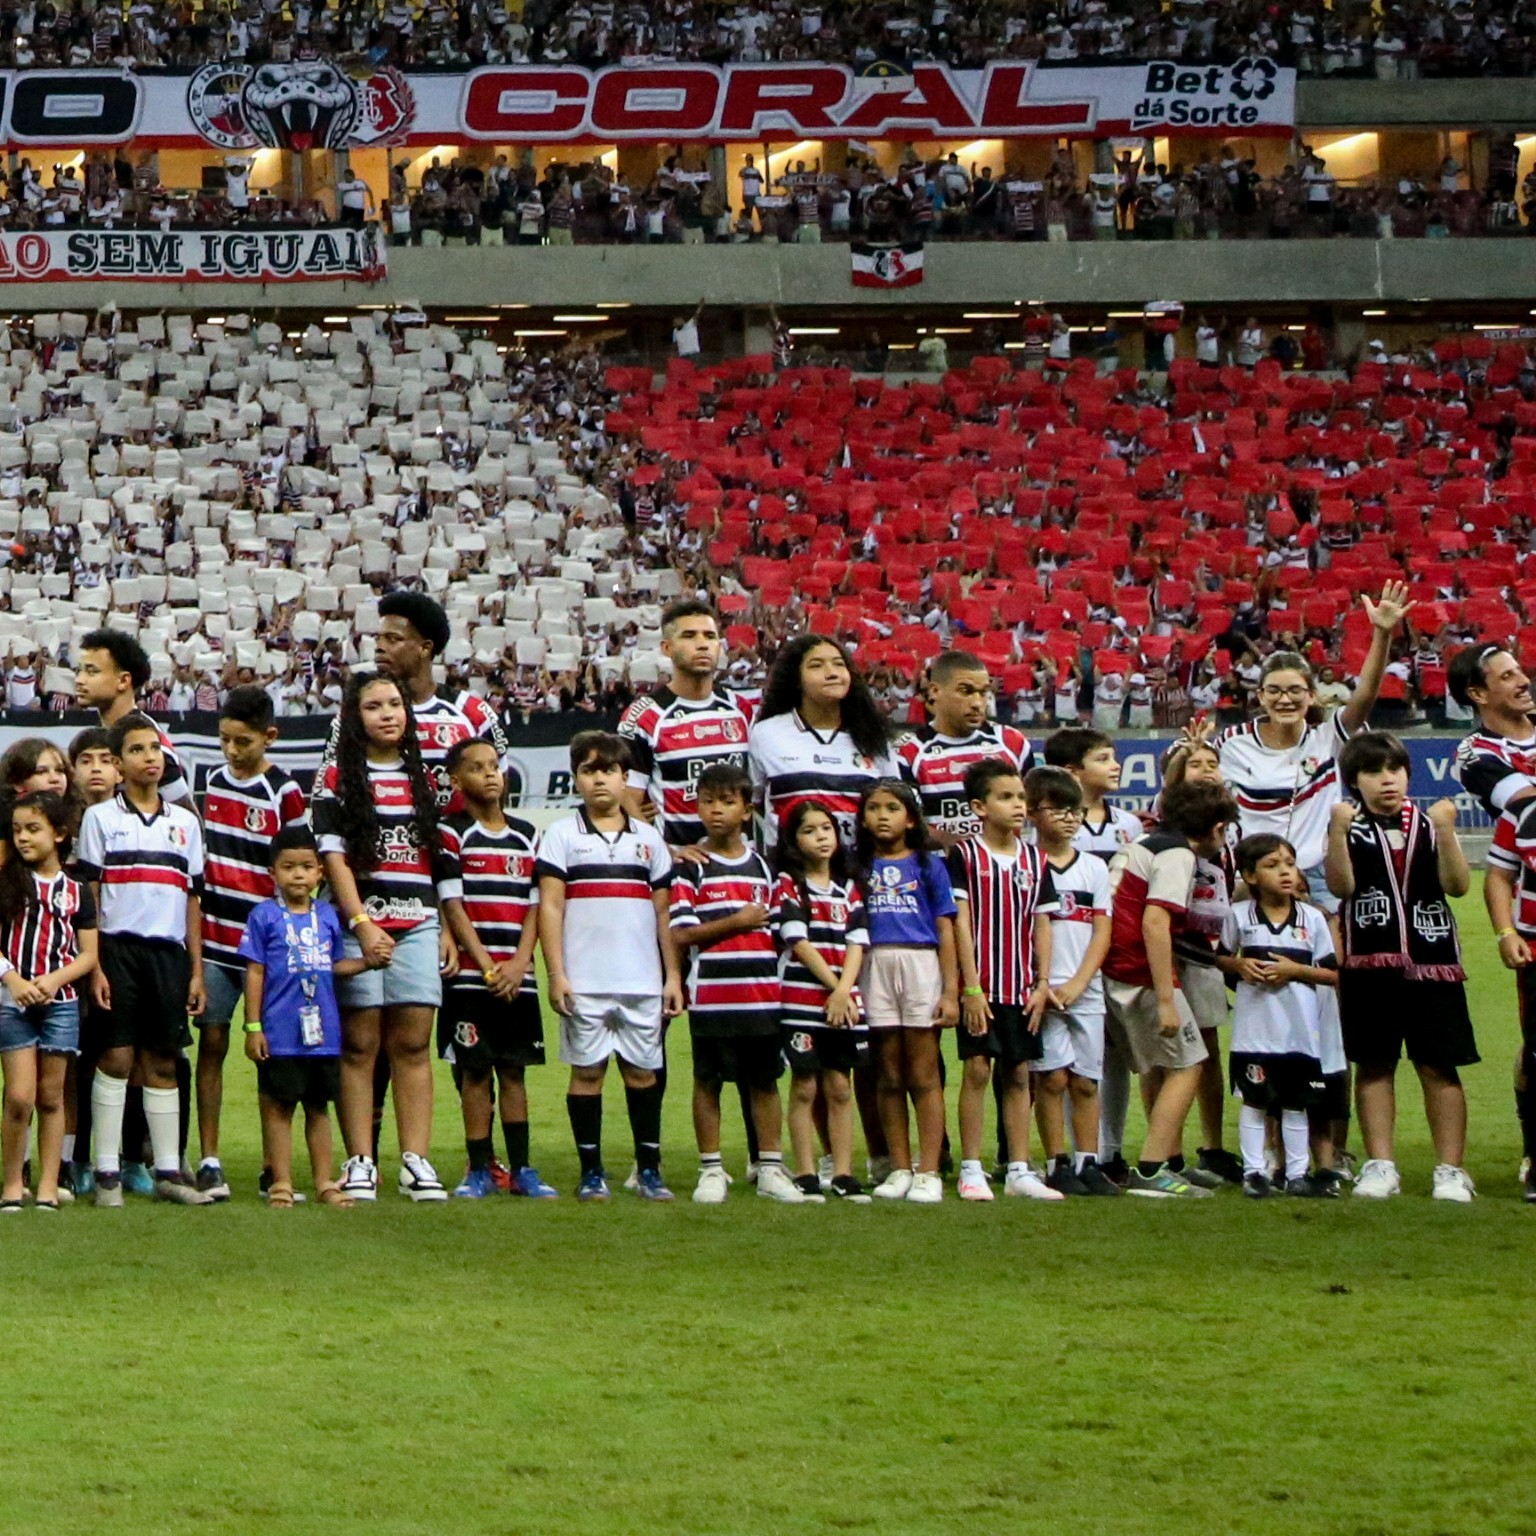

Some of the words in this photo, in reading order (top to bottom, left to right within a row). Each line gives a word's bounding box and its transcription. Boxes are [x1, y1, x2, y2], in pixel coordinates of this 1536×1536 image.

[1145, 64, 1224, 94] Bet
[461, 64, 1099, 138] CORAL
[1134, 98, 1165, 117] dá
[1170, 99, 1259, 124] Sorte
[67, 233, 183, 272] SEM
[942, 801, 972, 818] Be
[383, 826, 406, 844] et
